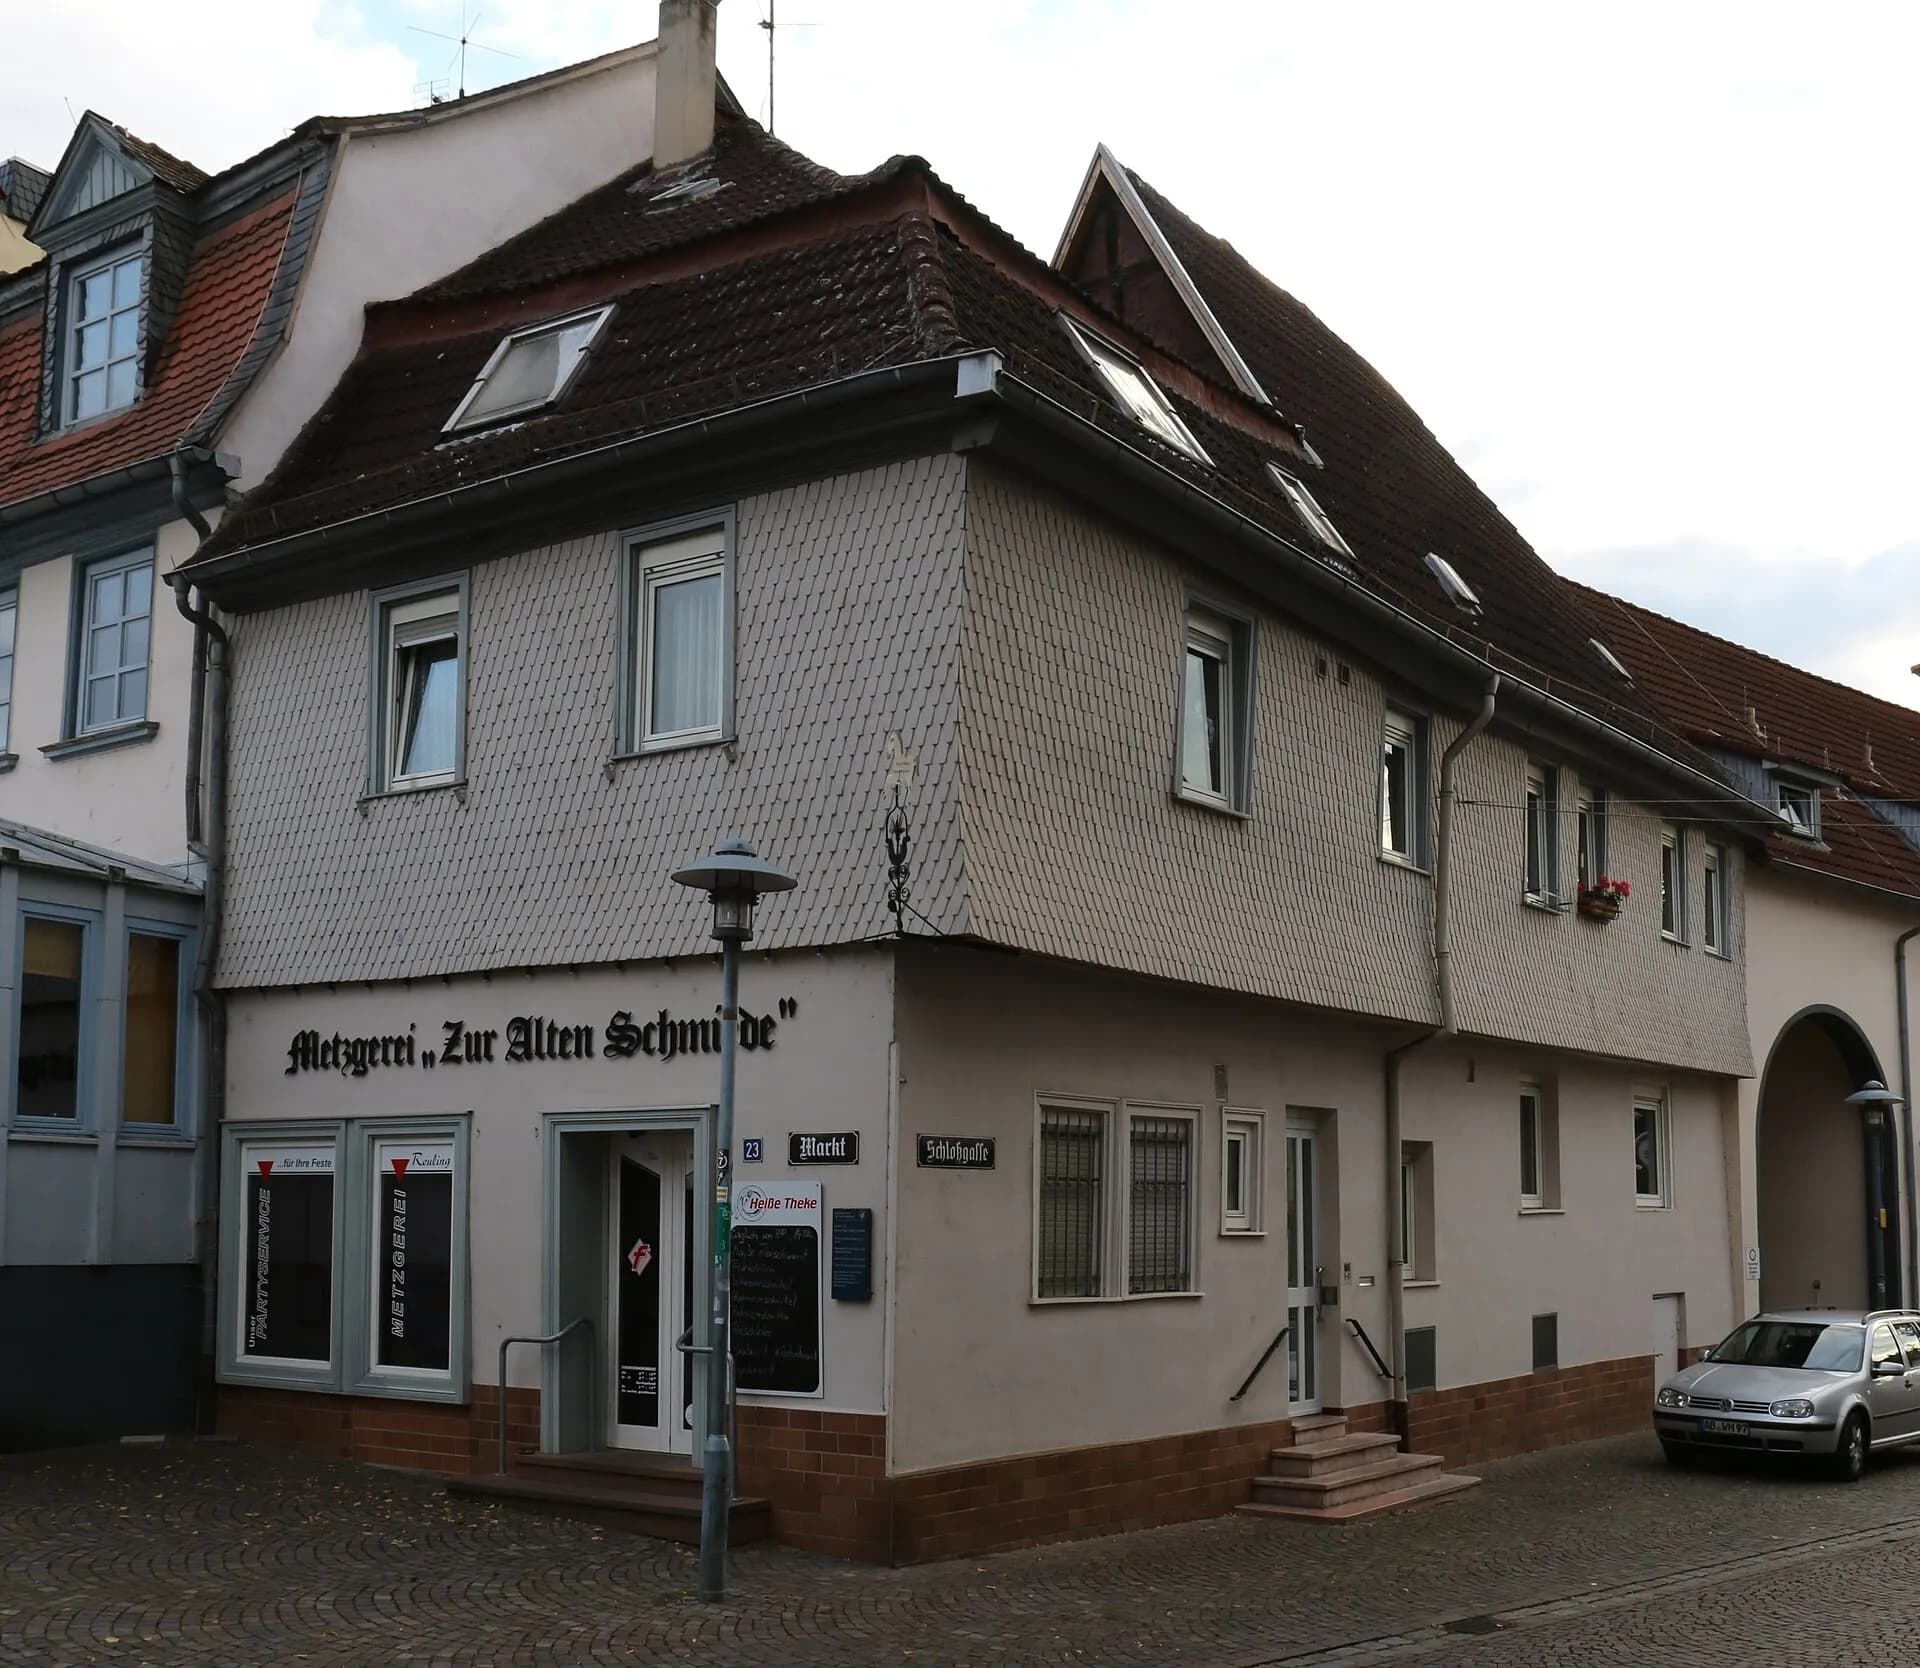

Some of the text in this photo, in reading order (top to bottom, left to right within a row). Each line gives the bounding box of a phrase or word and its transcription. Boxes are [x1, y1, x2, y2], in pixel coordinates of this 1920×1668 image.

[285, 1022, 416, 1077] Metzgerei
[505, 1015, 595, 1062] Alten
[603, 996, 798, 1062] Schmide"
[412, 1152, 451, 1168] Reuling
[745, 1142, 759, 1158] 23
[799, 1136, 846, 1160] Markt
[295, 1158, 310, 1168] Ihre
[311, 1157, 332, 1168] Feste
[750, 1197, 817, 1209] Heiße Theke
[256, 1188, 271, 1341] PARTYSERVICE
[391, 1188, 407, 1338] METZGEREI
[248, 1315, 257, 1348] Unser
